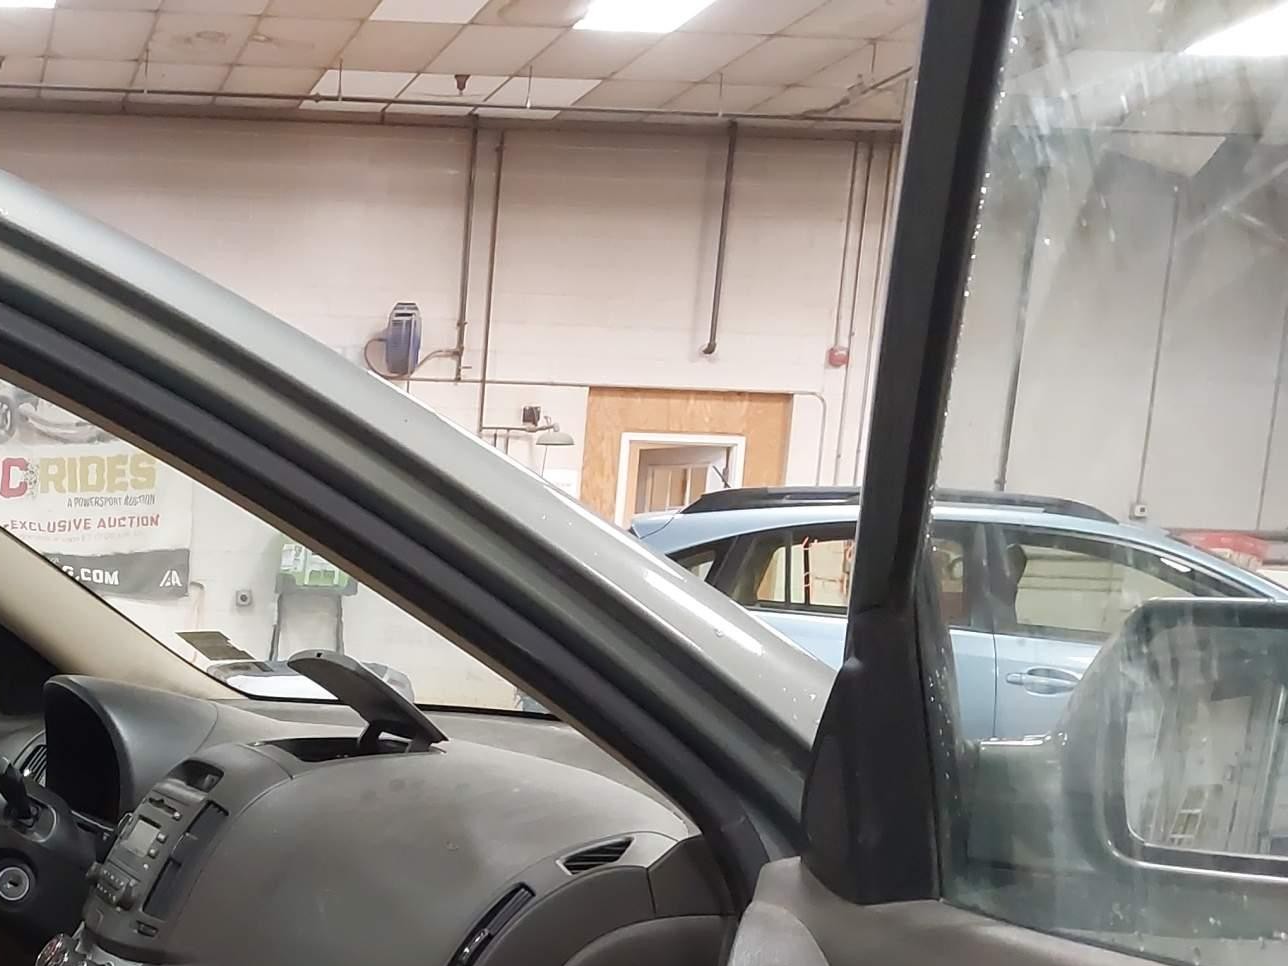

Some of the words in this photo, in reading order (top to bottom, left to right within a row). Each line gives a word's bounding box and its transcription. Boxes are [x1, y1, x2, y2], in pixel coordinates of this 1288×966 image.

[39, 454, 156, 493] RIDES
[66, 497, 73, 508] A
[123, 494, 156, 506] AUCTION
[96, 514, 160, 529] AUCTION
